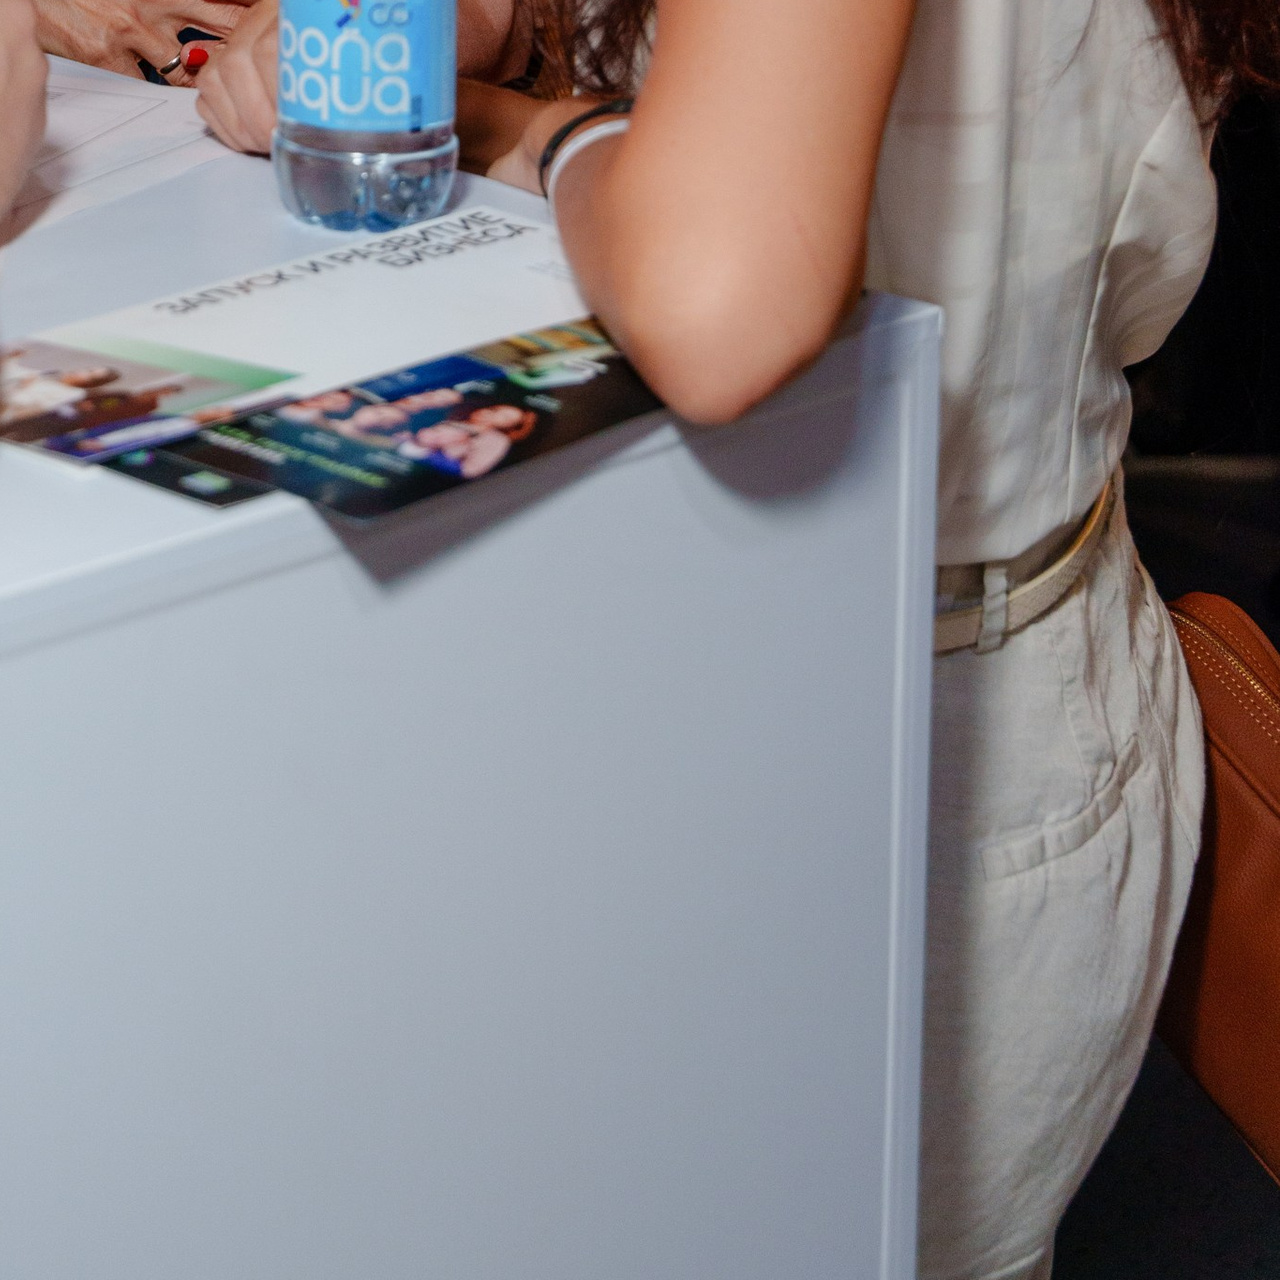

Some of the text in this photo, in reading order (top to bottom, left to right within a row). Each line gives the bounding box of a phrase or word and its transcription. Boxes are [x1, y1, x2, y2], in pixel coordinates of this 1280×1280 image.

[154, 209, 506, 313] ЗАПУСК И РАЗВИТИЕ
[376, 221, 538, 269] БИЗНЕСА
